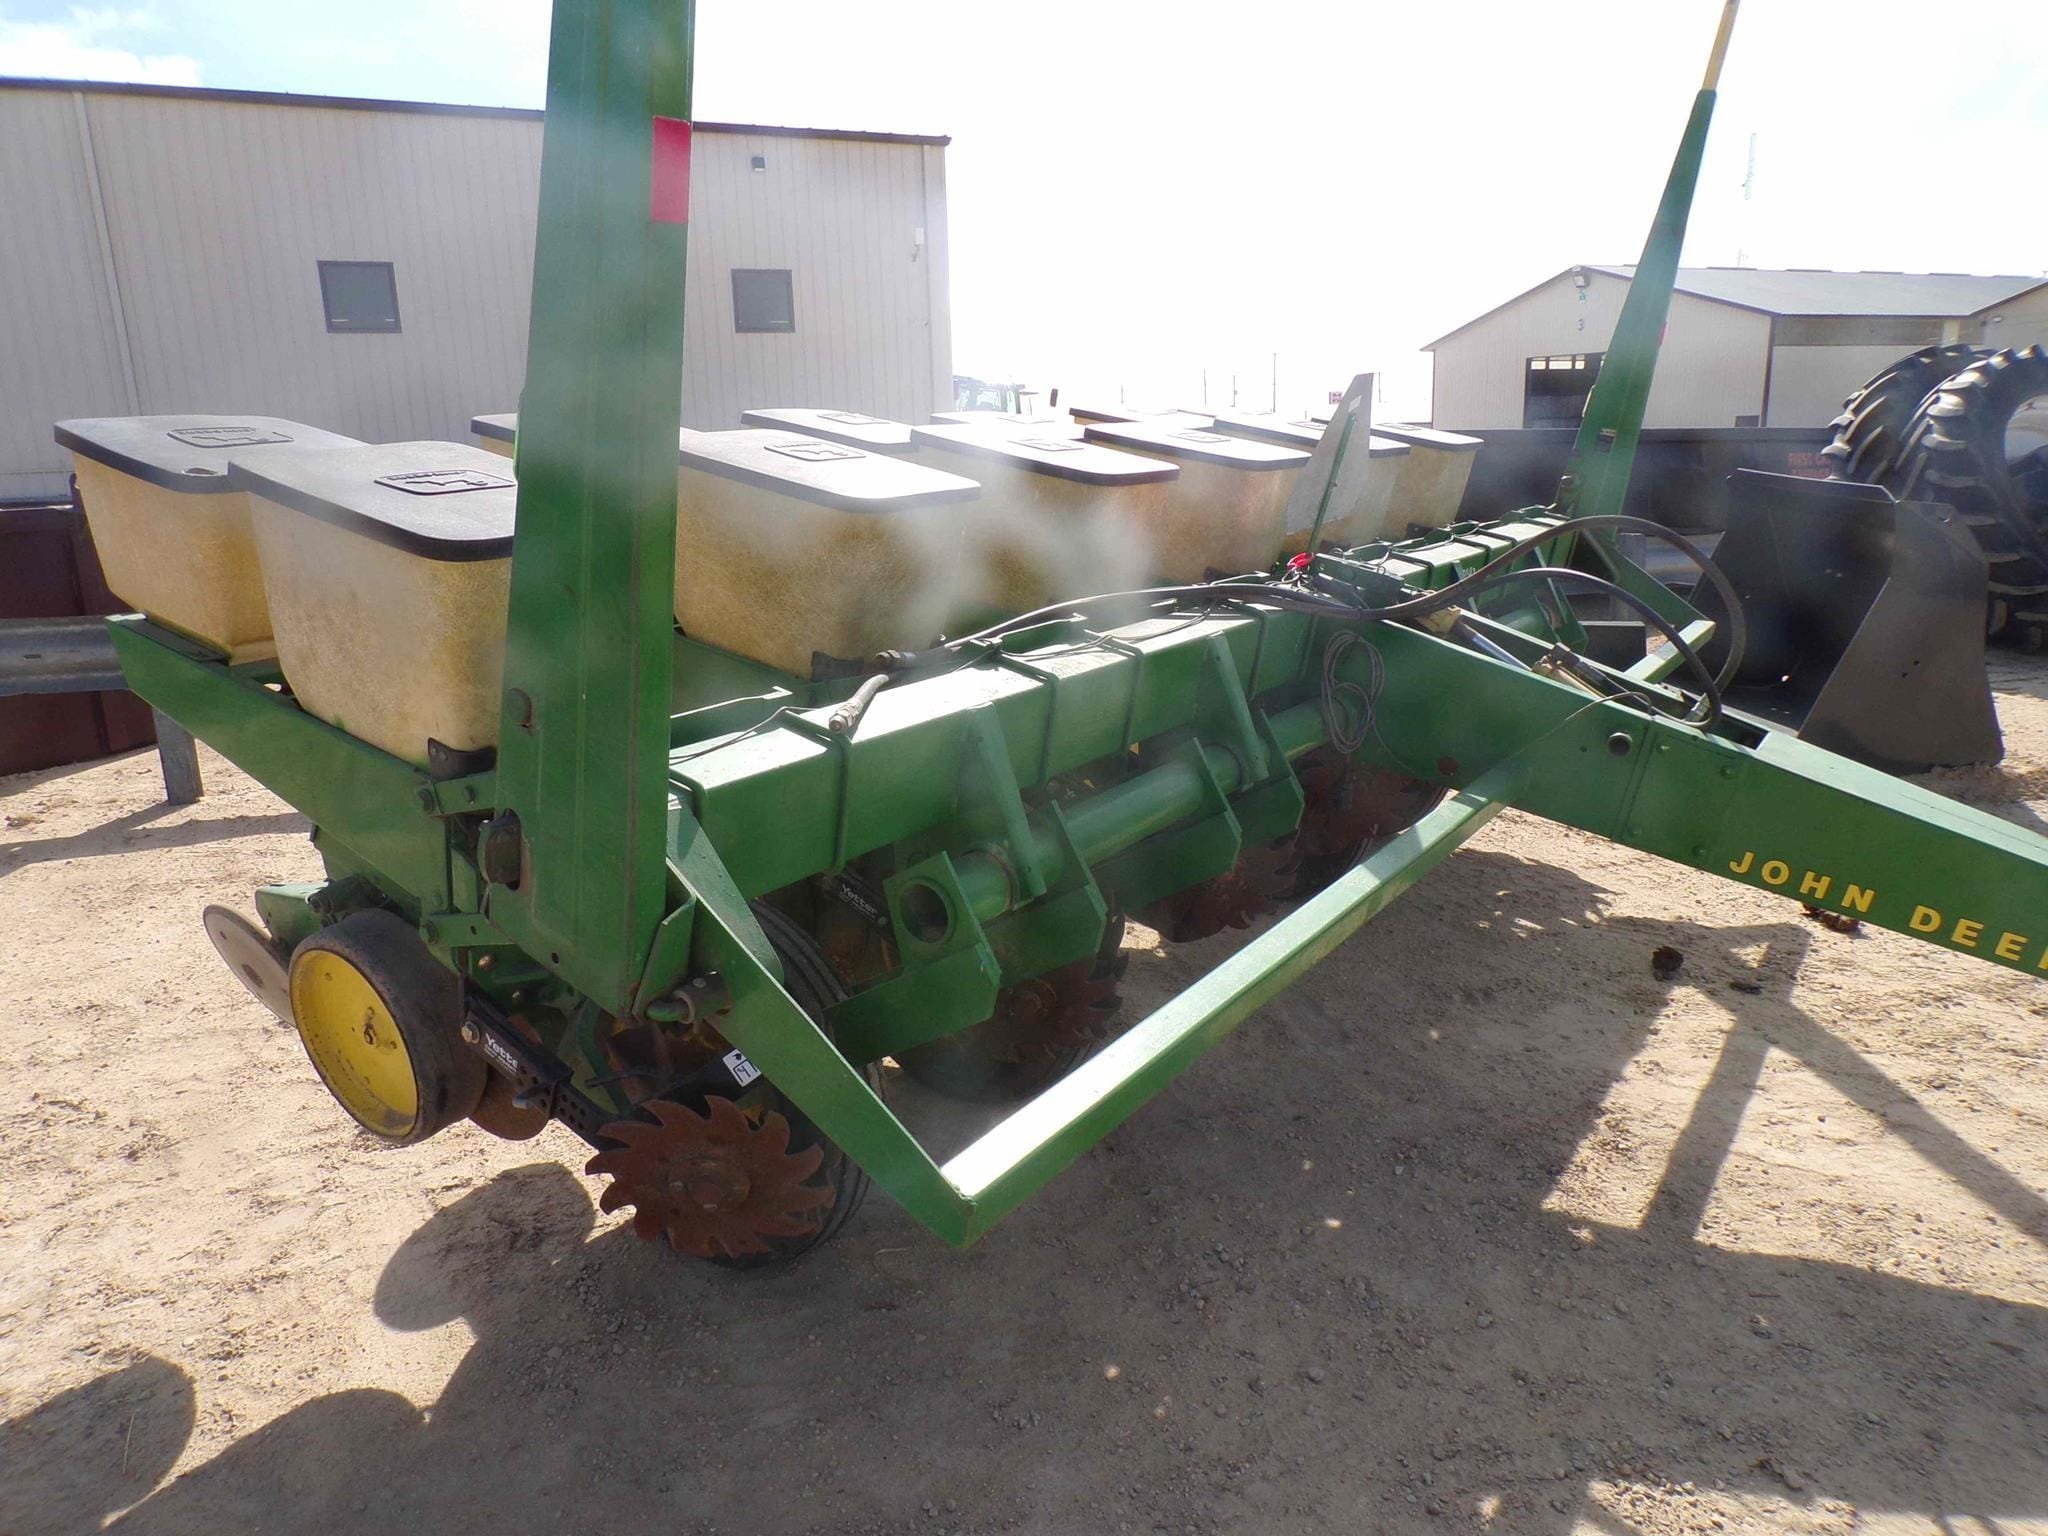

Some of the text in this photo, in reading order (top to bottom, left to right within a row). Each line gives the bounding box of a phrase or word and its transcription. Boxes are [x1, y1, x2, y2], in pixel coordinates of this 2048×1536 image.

[841, 883, 878, 914] Yetter
[1728, 851, 1875, 913] JOHN
[485, 1032, 518, 1069] Yette
